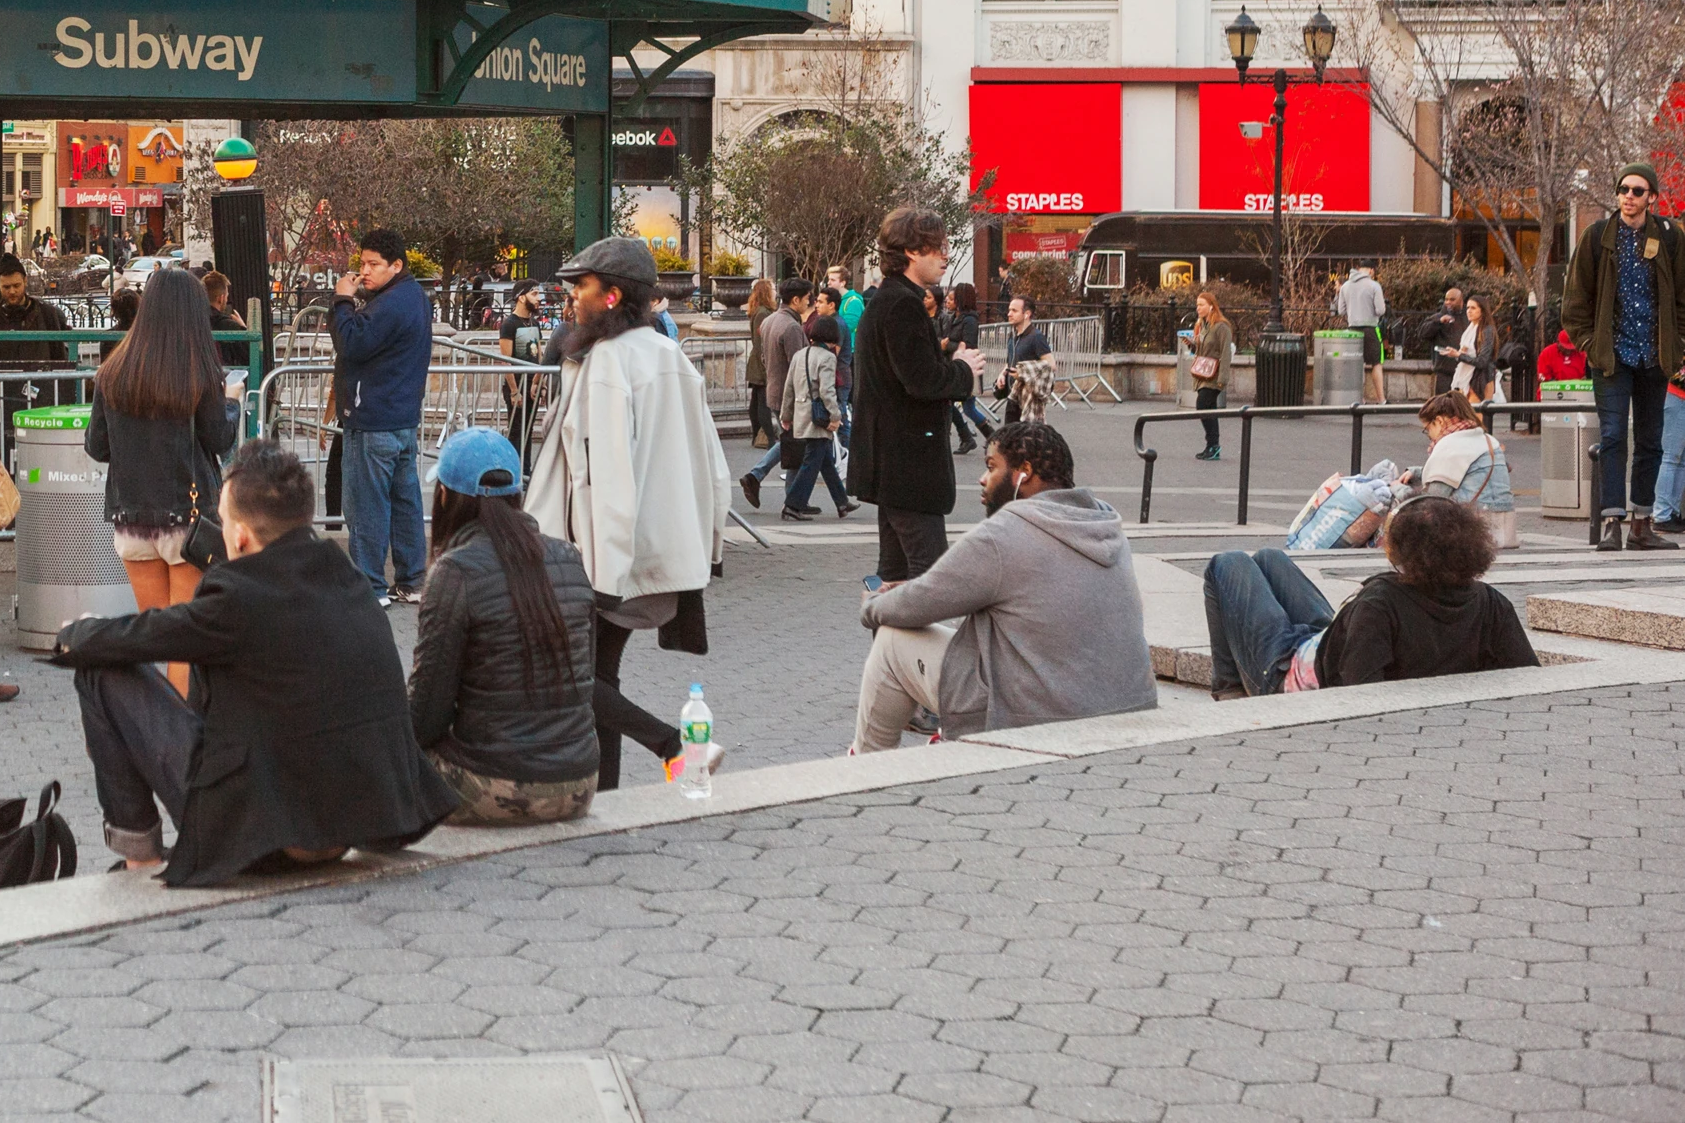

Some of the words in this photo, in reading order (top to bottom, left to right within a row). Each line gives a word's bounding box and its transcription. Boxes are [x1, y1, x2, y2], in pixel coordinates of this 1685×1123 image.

[53, 16, 264, 81] Subway
[528, 37, 586, 92] Square
[612, 130, 656, 146] ebok
[76, 190, 108, 205] Wendy's
[1006, 192, 1084, 210] STAPLES
[24, 417, 64, 428] Recycle
[48, 470, 86, 482] Mixed
